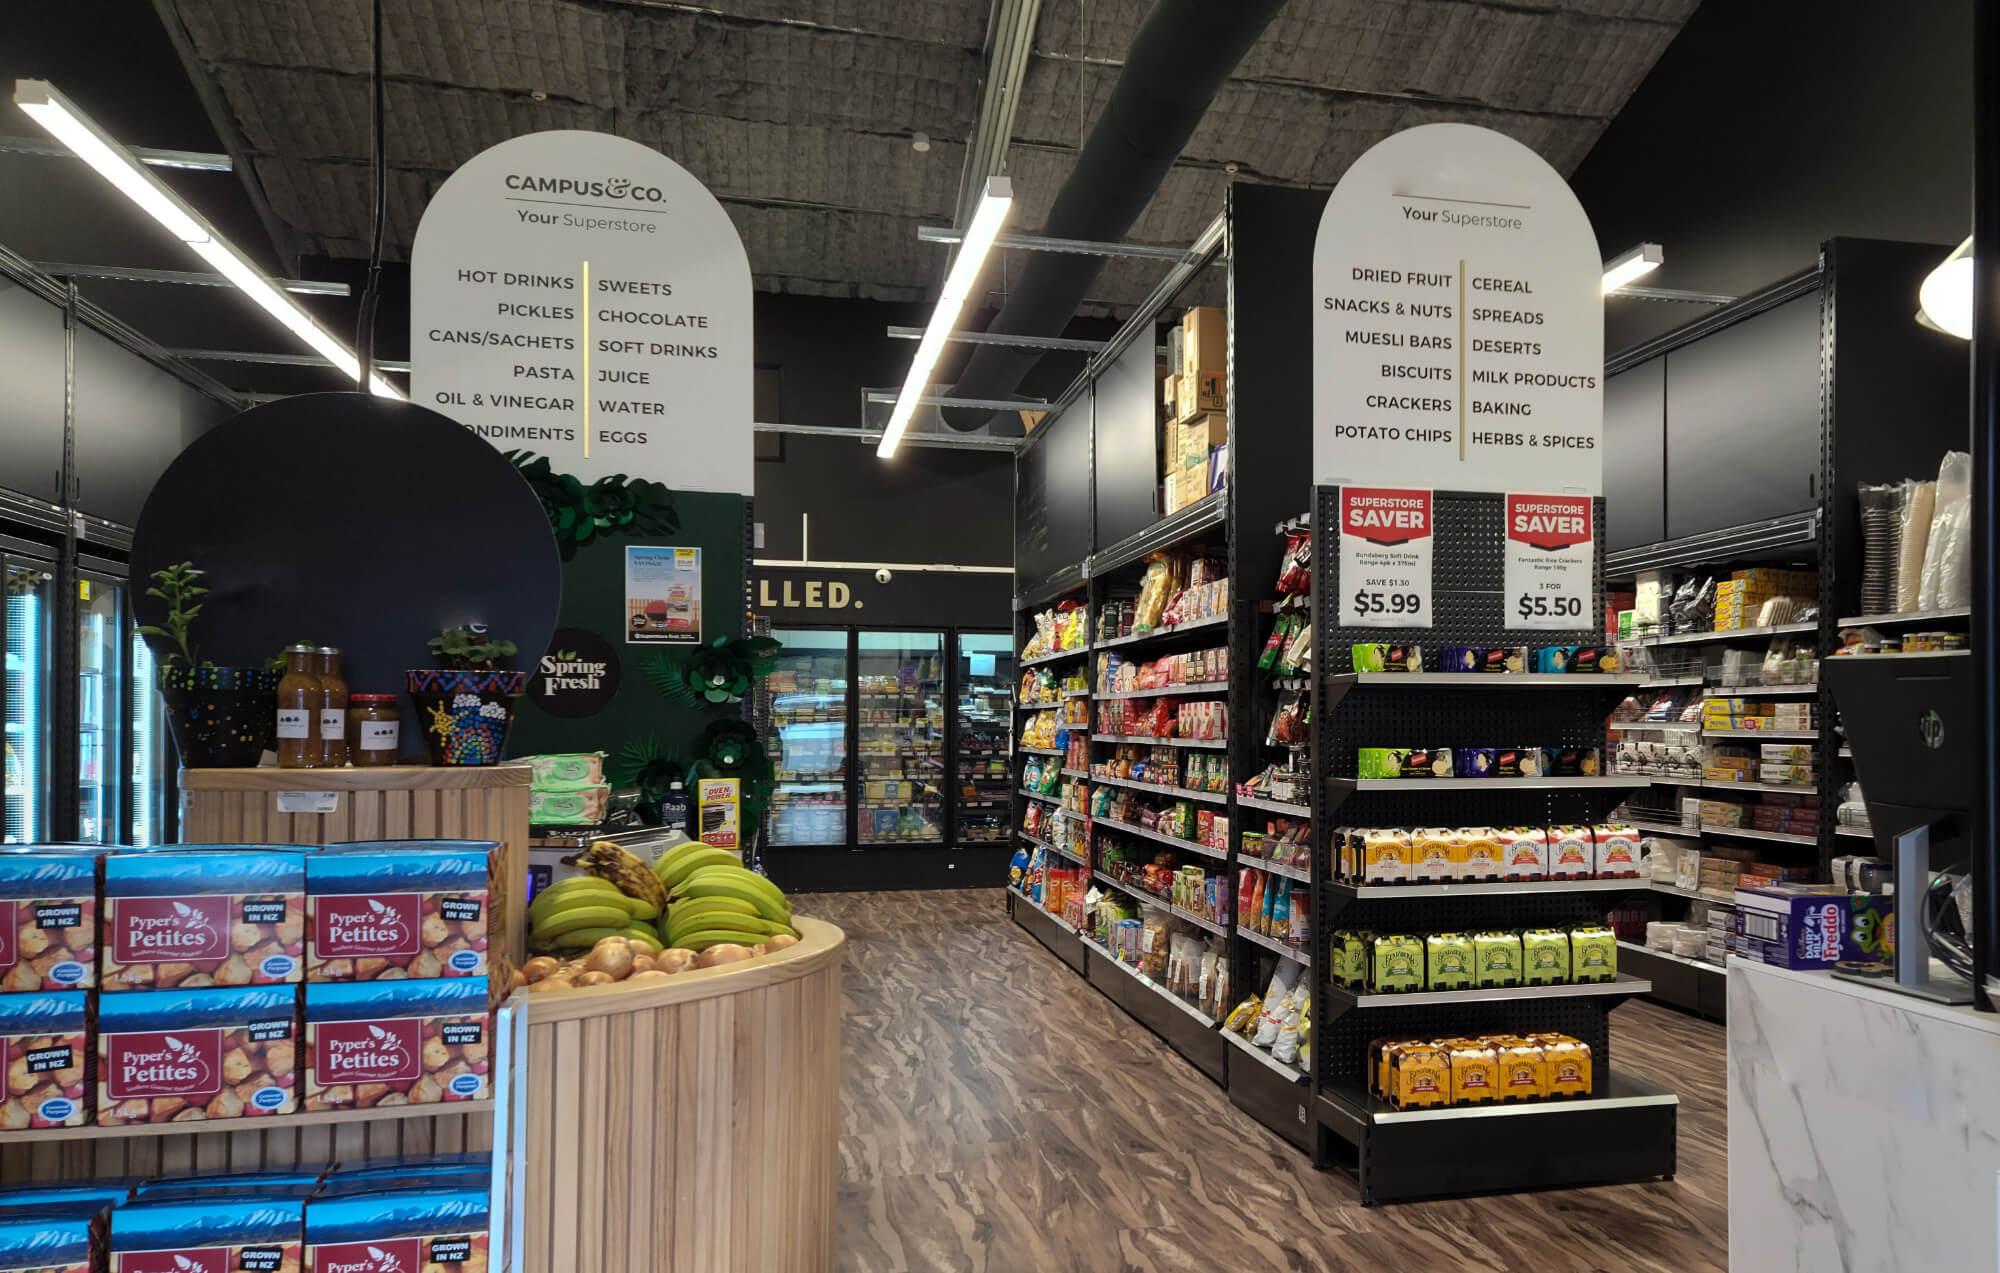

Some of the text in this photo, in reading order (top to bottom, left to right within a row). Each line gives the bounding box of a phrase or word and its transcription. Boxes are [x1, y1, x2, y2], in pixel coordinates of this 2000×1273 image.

[518, 210, 656, 234] Your Superstore
[1402, 206, 1522, 230] Your Superstore
[458, 270, 574, 290] HOT DRINKS
[1352, 268, 1452, 288] DRIED FRUIT
[1472, 278, 1533, 294] CEREAL
[598, 280, 672, 296] SWEETS
[498, 302, 574, 320] PICKLES
[1324, 297, 1452, 319] SNACKS & NUTS
[1472, 308, 1544, 325] SPREADS
[598, 310, 708, 328] CHOCOLATE
[428, 328, 574, 350] CANS/SACHETS
[1345, 330, 1452, 350] MUESLI BARS
[1472, 339, 1542, 356] DESERTS
[598, 340, 718, 359] SOFT DRINKS
[514, 366, 575, 381] PASTA
[598, 370, 650, 385] JUICE
[1381, 364, 1452, 381] BISCUITS
[1472, 370, 1596, 389] MILK PRODUCTS
[435, 391, 574, 412] OIL & VINEGAR
[598, 400, 665, 416] WATER
[1366, 395, 1452, 412] CRACKERS
[1472, 401, 1532, 416] BAKING
[464, 424, 574, 442] ONDIMENTS
[599, 430, 648, 445] EGGS
[1335, 425, 1452, 442] POTATO CHIPS
[1472, 432, 1595, 449] HERBS & SPICES
[1350, 496, 1424, 510] SUPERSTORE
[1514, 503, 1584, 516] SUPERSTORE
[1350, 509, 1424, 529] SAVER
[1514, 516, 1584, 534] SAVER
[1366, 578, 1387, 586] SAVE
[760, 579, 864, 608] LLED.
[1354, 588, 1420, 617] $5.99
[1518, 592, 1582, 620] $5.50
[540, 654, 607, 678] Spring
[544, 672, 600, 696] Fresh
[708, 786, 730, 794] OVEN
[37, 907, 79, 917] GROWN
[244, 904, 284, 912] GROWN
[442, 901, 479, 911] GROWN
[42, 918, 74, 926] IN NZ
[130, 914, 180, 930] Pyper's
[248, 914, 278, 922] IN NZ
[330, 912, 375, 927] Pyper's
[459, 912, 473, 920] NZ
[128, 930, 206, 948] Petites
[328, 926, 399, 944] Petites
[1823, 906, 1838, 958] Freddo
[1806, 926, 1814, 959] DAIRY
[1813, 932, 1822, 958] MILK
[250, 1020, 289, 1030] GROWN
[443, 1026, 480, 1034] GROWN
[254, 1031, 284, 1040] IN NZ
[448, 1035, 458, 1043] IN
[330, 1038, 375, 1053] Pyper's
[28, 1049, 70, 1062] GROWN
[123, 1050, 172, 1066] Pyper's
[330, 1052, 399, 1070] Petites
[34, 1060, 65, 1071] IN NZ
[122, 1065, 198, 1083] Petites
[241, 1251, 280, 1259] GROWN
[432, 1242, 468, 1252] GROWN
[436, 1252, 464, 1262] IN NZ
